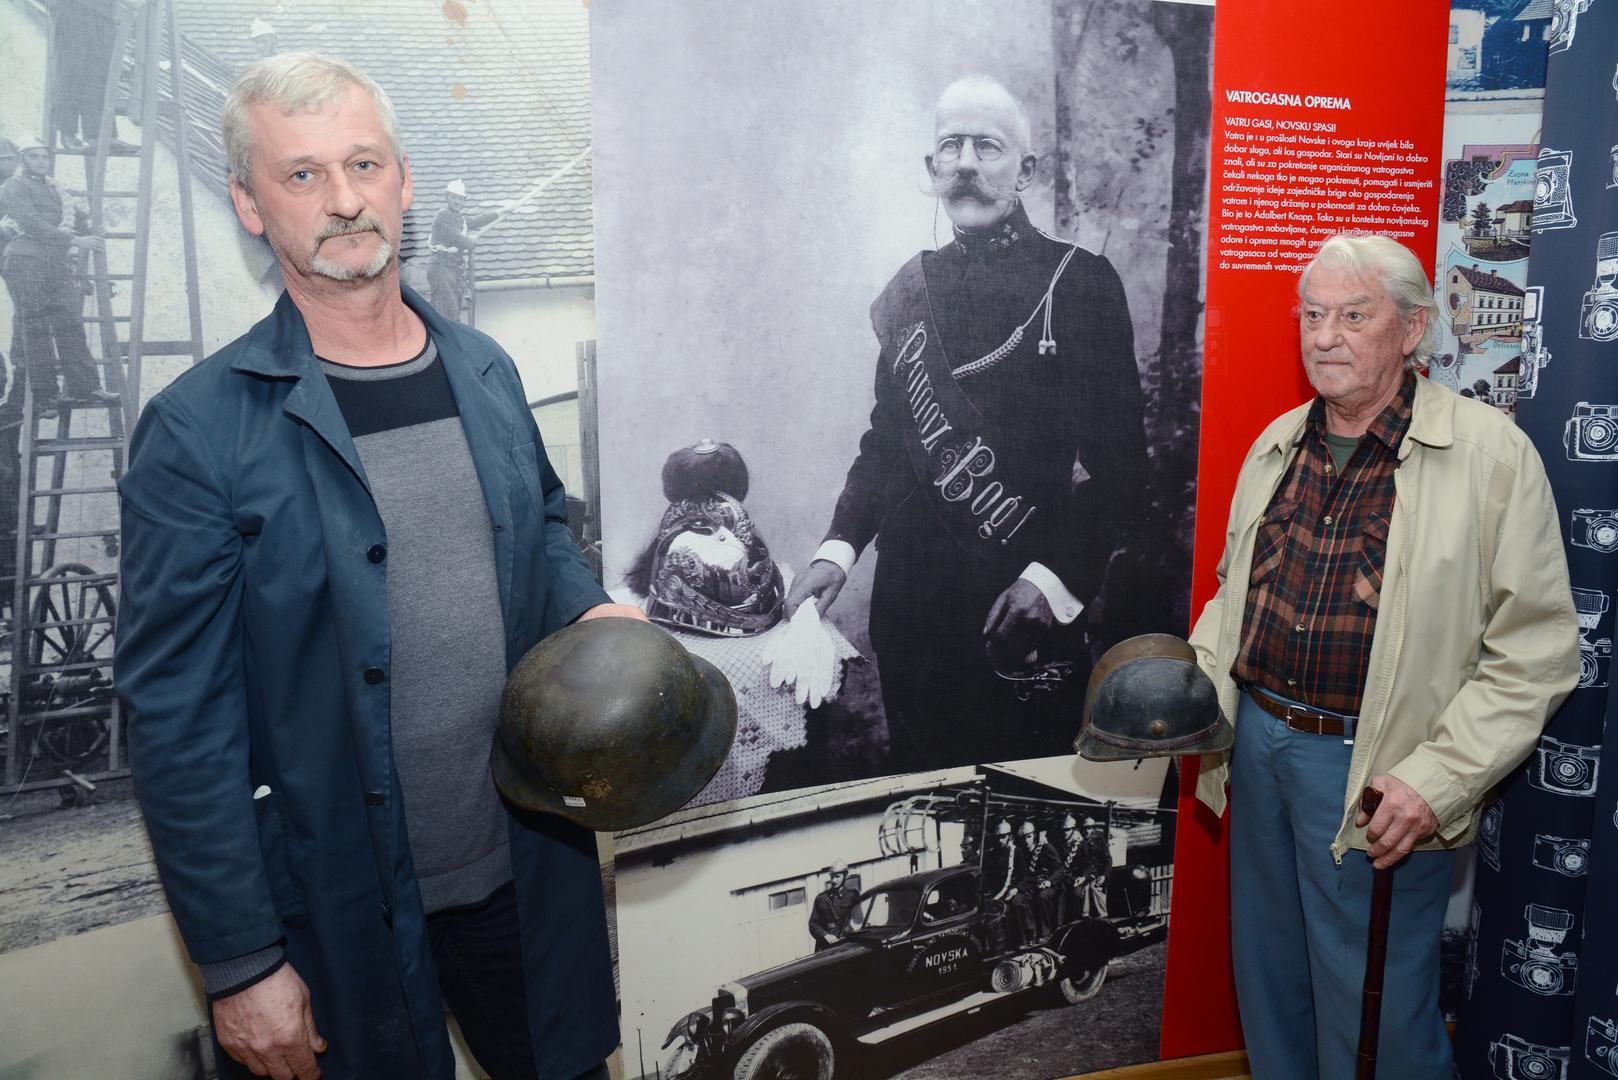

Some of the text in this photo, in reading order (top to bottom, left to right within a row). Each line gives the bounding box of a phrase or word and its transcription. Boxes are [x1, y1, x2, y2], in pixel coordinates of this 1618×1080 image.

[1225, 89, 1351, 110] VATROGASNA OPREMA
[1224, 116, 1337, 133] VATRU GASI, NOVSKU SPASI!
[1224, 130, 1244, 140] Vatra
[1246, 132, 1253, 142] je
[1266, 133, 1297, 144] prošlosti
[1298, 135, 1326, 145] Novske
[1332, 139, 1355, 149] ovoga
[1356, 138, 1376, 149] kraja
[1377, 140, 1399, 151] uvijek
[1400, 140, 1414, 150] bila
[1223, 143, 1247, 153] dobar
[1249, 145, 1271, 157] sluga,
[1272, 146, 1283, 155] ali
[1296, 149, 1334, 159] gospodar.
[1335, 150, 1352, 159] Stari
[1354, 152, 1362, 160] su
[1364, 152, 1395, 163] Novljani
[1396, 154, 1404, 162] to
[1405, 154, 1429, 163] dobro
[1223, 157, 1244, 168] znali,
[1246, 158, 1256, 167] ali
[1278, 160, 1318, 172] pokretanje
[1318, 163, 1370, 175] organiziranog
[1372, 166, 1414, 176] vatrogastva
[1223, 169, 1246, 179] čekali
[1246, 171, 1275, 183] nekoga
[1276, 172, 1288, 182] tko
[1289, 173, 1297, 183] je
[1298, 177, 1325, 185] mogao
[1326, 175, 1362, 186] pokrenuti,
[1404, 180, 1433, 190] usmjeriti
[1222, 183, 1414, 202] održavanje ideje zajedničke brige oko gospodarenja
[1222, 197, 1248, 206] vatrom
[1254, 198, 1279, 209] njenog
[1280, 198, 1310, 210] držanja
[1356, 203, 1366, 211] za
[1368, 202, 1391, 212] dobro
[1392, 203, 1422, 214] čovjeka.
[1222, 208, 1234, 218] Bio
[1236, 210, 1243, 220] je
[1244, 211, 1252, 219] to
[1254, 210, 1287, 220] Adalbert
[1288, 212, 1315, 223] Knapp.
[1316, 212, 1334, 222] Tako
[1336, 215, 1344, 223] su
[1352, 214, 1385, 224] kontekstu
[1386, 215, 1429, 228] novljanskog
[1221, 223, 1264, 233] vatrogastva
[1266, 224, 1309, 236] nabavljane,
[1310, 226, 1336, 235] čuvane
[1375, 229, 1415, 239] vatrogasne
[1249, 239, 1278, 247] oprema
[1280, 237, 1307, 248] mnogih
[1220, 249, 1266, 259] vatrogasaca
[1268, 249, 1279, 258] od
[1220, 260, 1230, 270] do
[1232, 261, 1273, 270] suvremenih
[934, 436, 1037, 546] Bog!
[925, 947, 968, 968] NOVSKA
[938, 963, 957, 975] 1951
